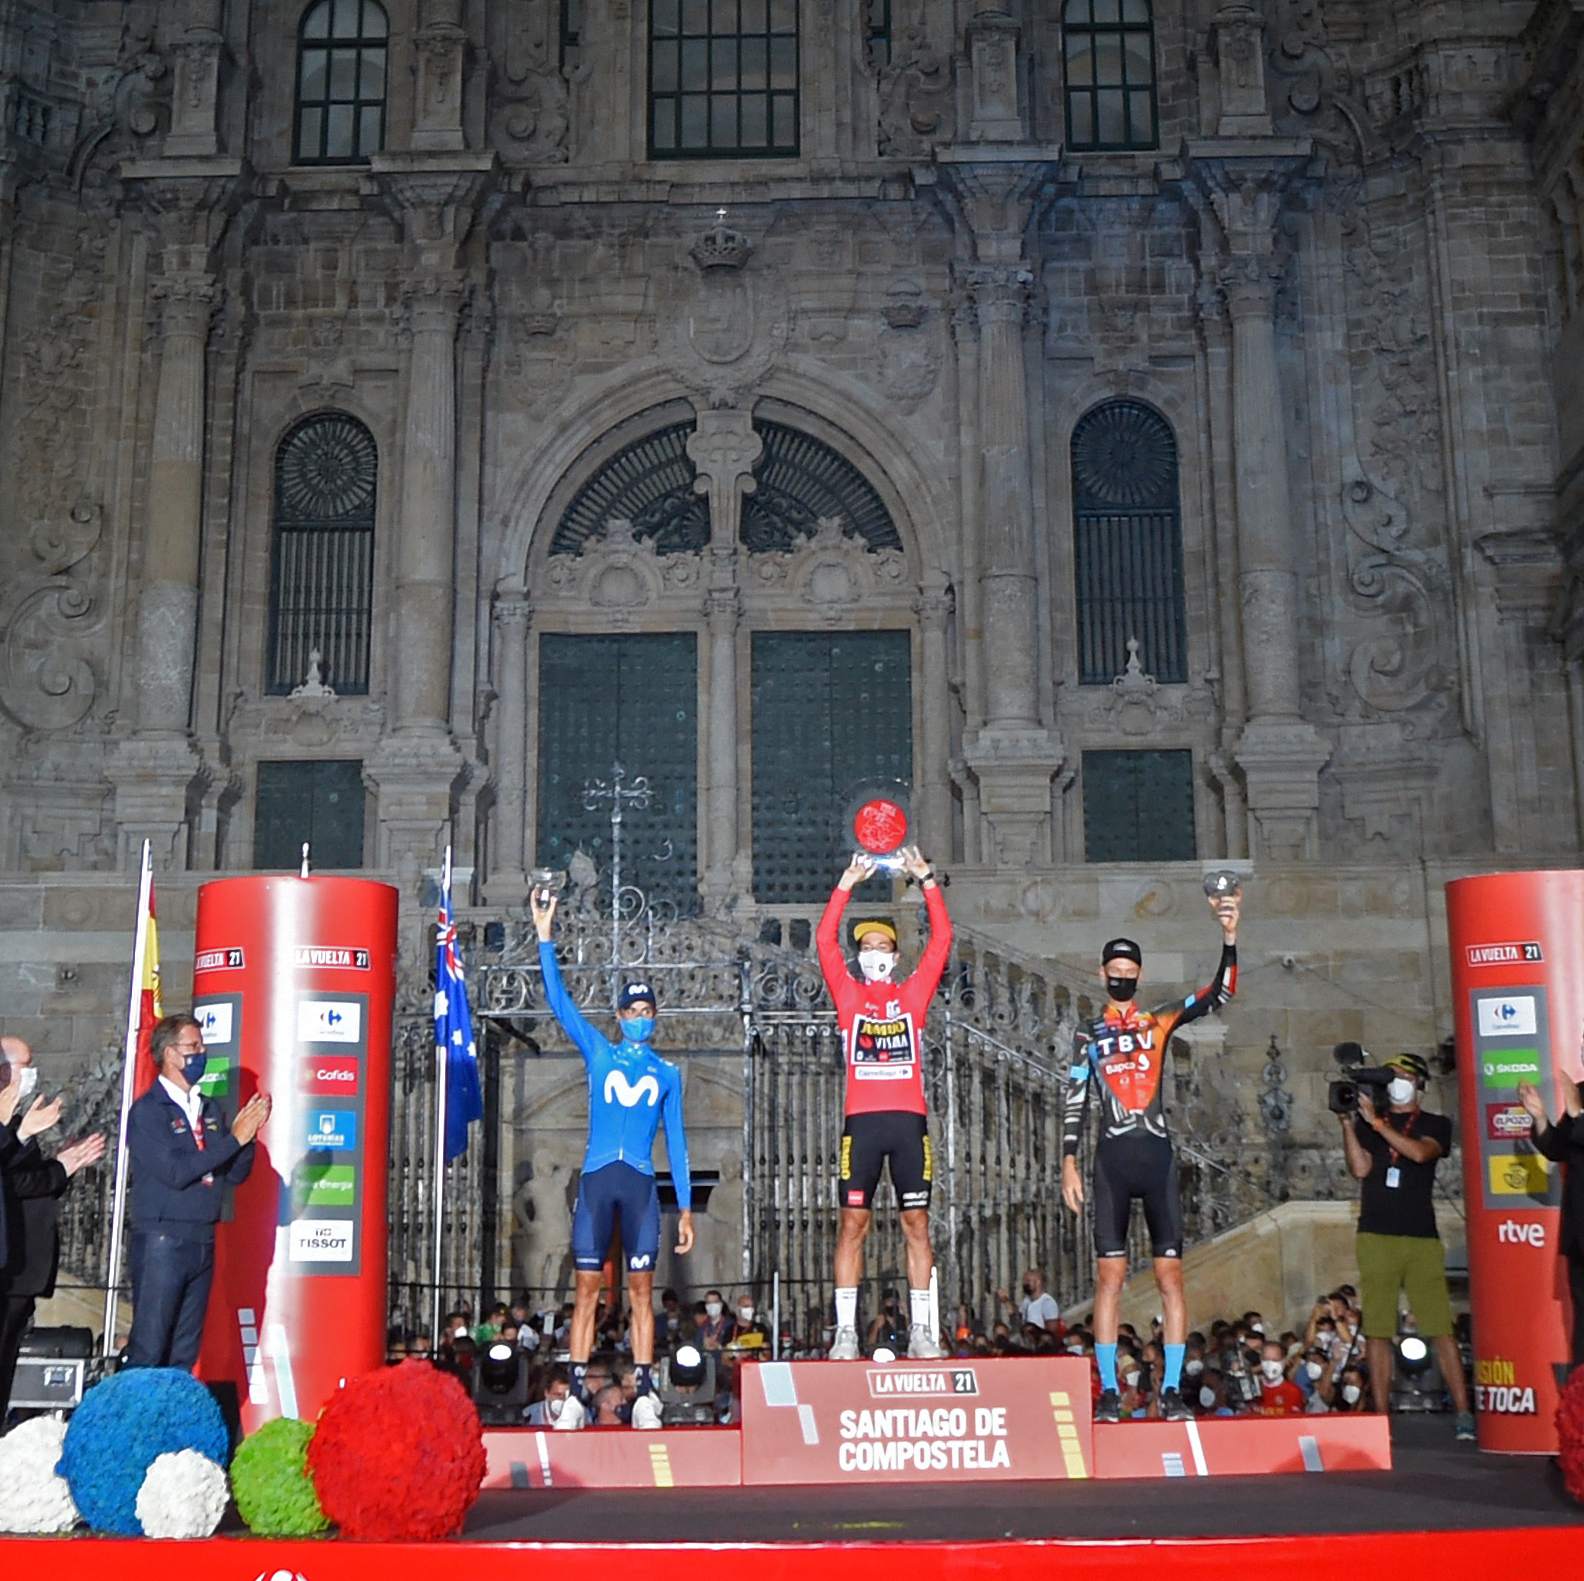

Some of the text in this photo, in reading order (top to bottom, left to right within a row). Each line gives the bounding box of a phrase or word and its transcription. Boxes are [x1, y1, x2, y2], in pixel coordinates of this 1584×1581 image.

[228, 951, 241, 966] 21
[296, 949, 367, 966] LA VUELTA 21
[1471, 945, 1538, 962] LA VUELTA 21
[1098, 1030, 1154, 1055] TBV
[1106, 1061, 1135, 1074] Bapco
[299, 1238, 347, 1249] TISSOT
[1498, 1220, 1546, 1248] rtve
[876, 1373, 971, 1393] LA VUELTA 21
[1487, 1386, 1535, 1413] TOCA
[840, 1407, 1007, 1439] SANTIAGO DE
[839, 1440, 1011, 1471] COMPOSTELA
